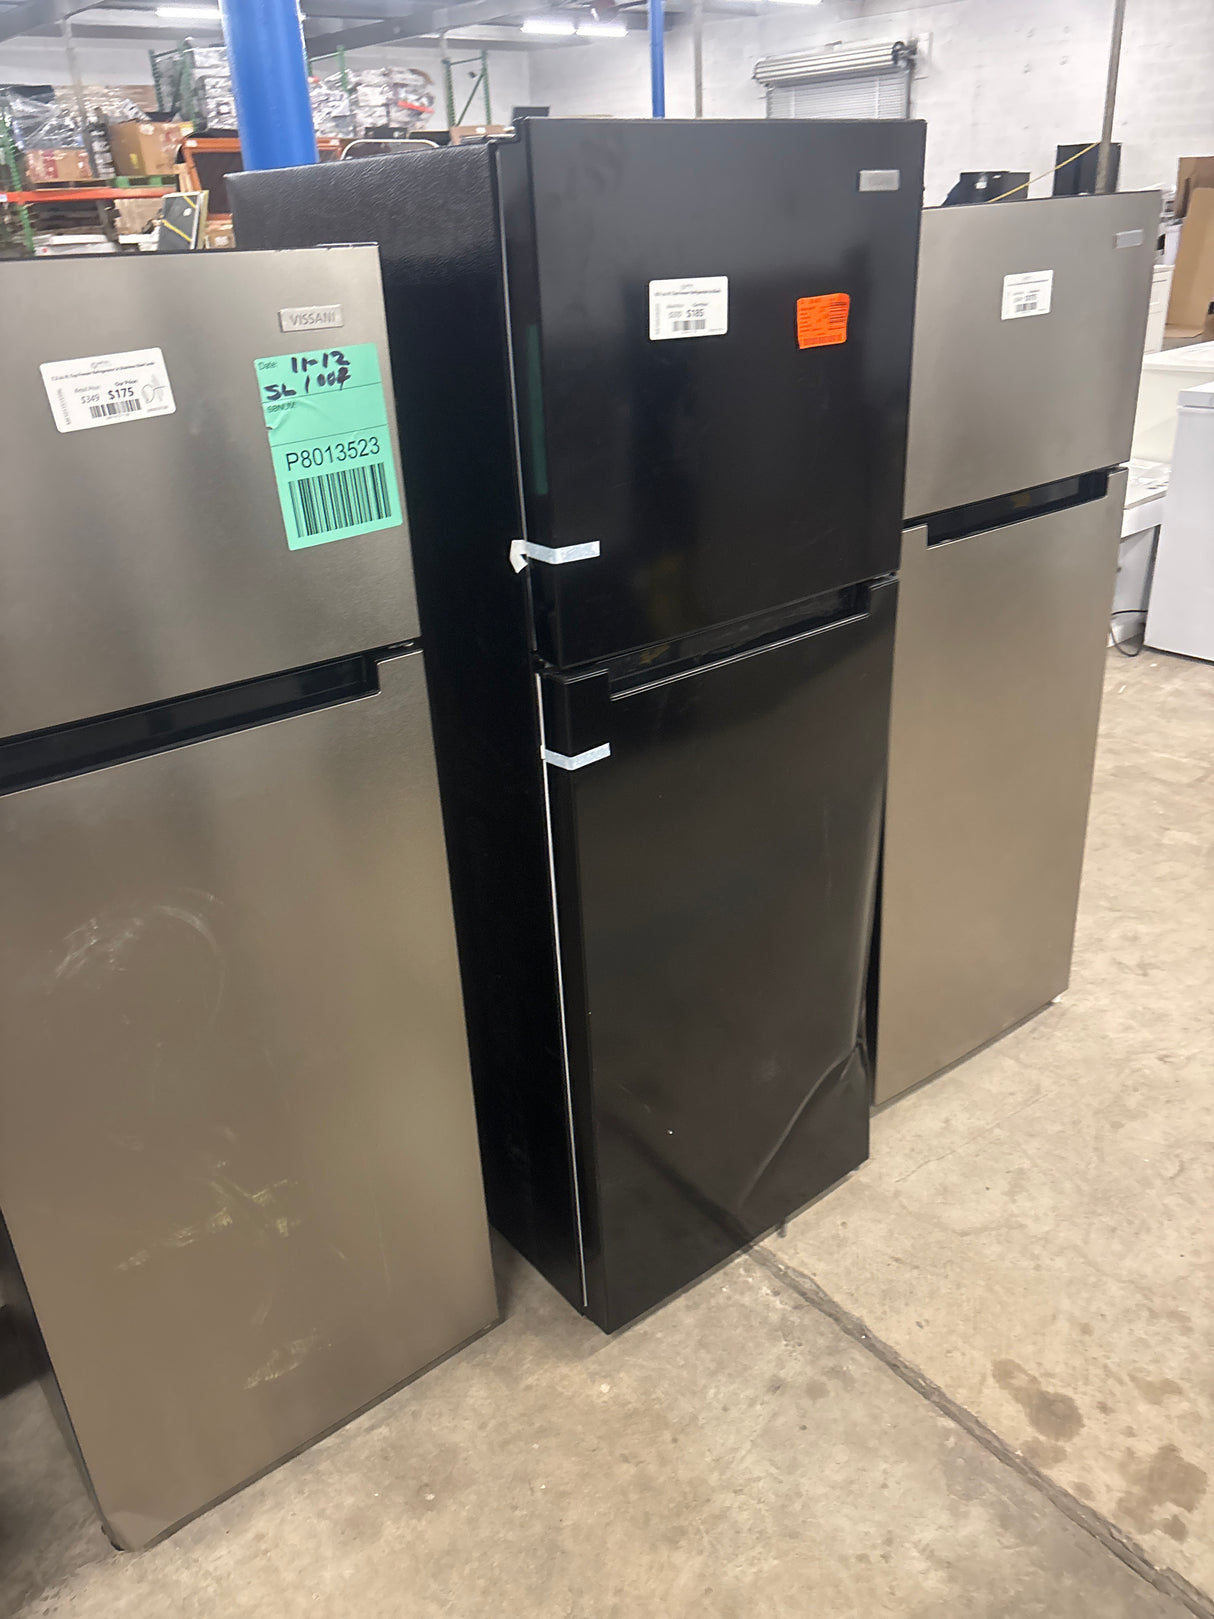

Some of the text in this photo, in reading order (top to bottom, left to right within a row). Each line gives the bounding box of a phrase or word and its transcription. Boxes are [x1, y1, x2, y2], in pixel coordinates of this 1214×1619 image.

[289, 311, 336, 325] VISSANI
[81, 393, 100, 404] $349
[108, 387, 134, 400] $175
[286, 436, 380, 471] P8013523
